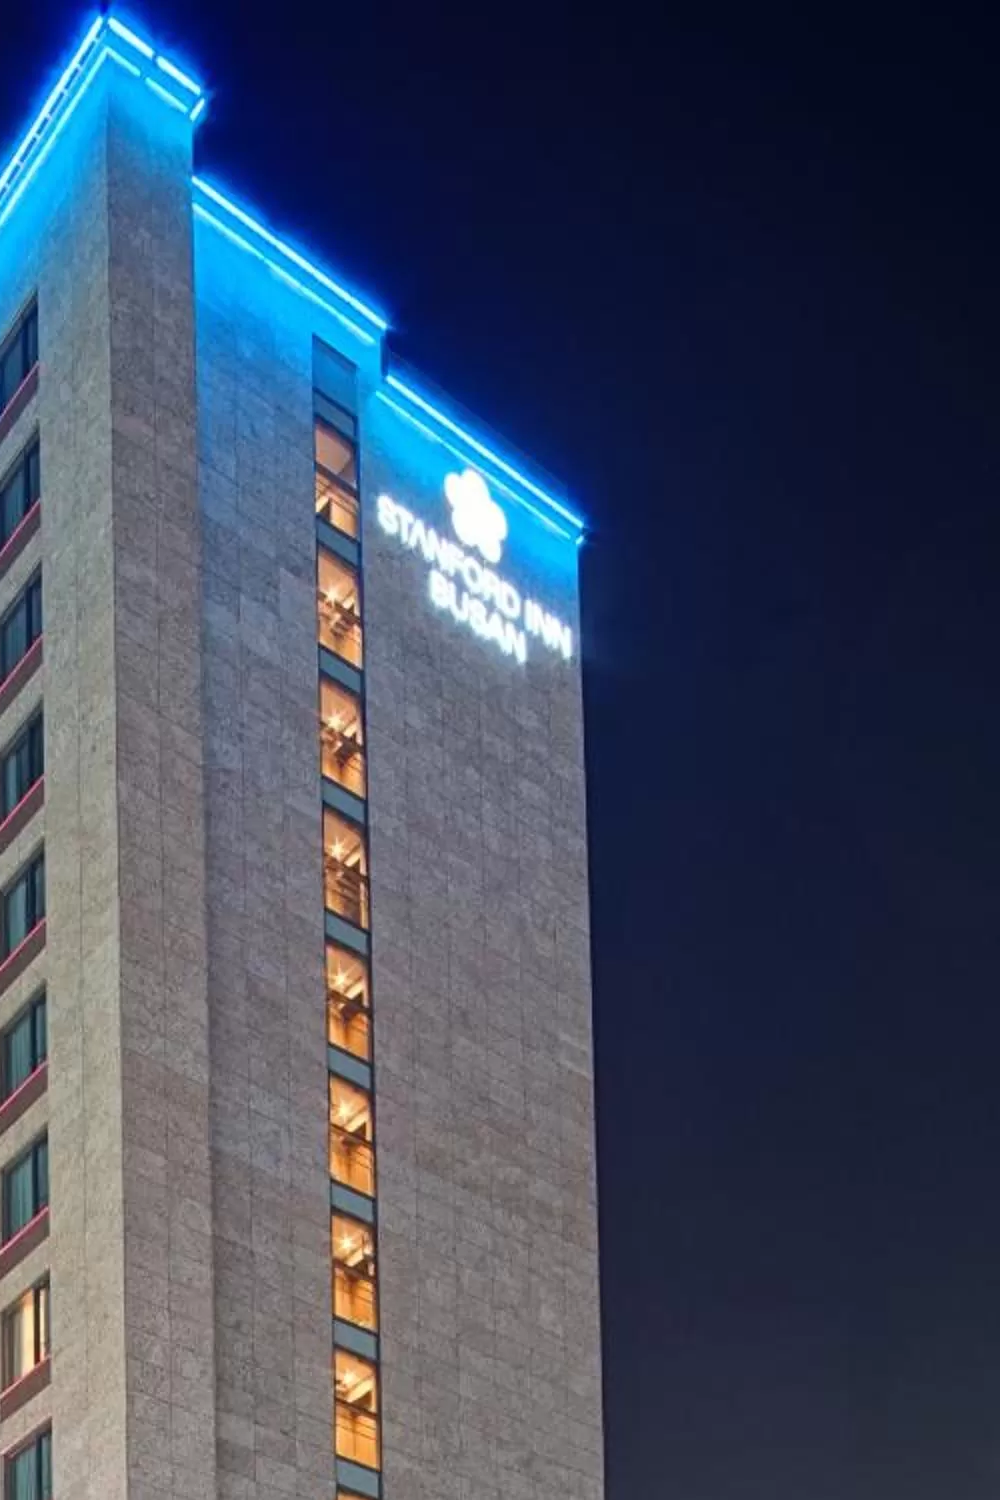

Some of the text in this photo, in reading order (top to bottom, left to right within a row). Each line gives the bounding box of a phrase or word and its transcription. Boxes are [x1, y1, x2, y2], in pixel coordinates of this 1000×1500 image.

[377, 494, 572, 661] STANFORD INN
[429, 569, 528, 665] BUSAN
